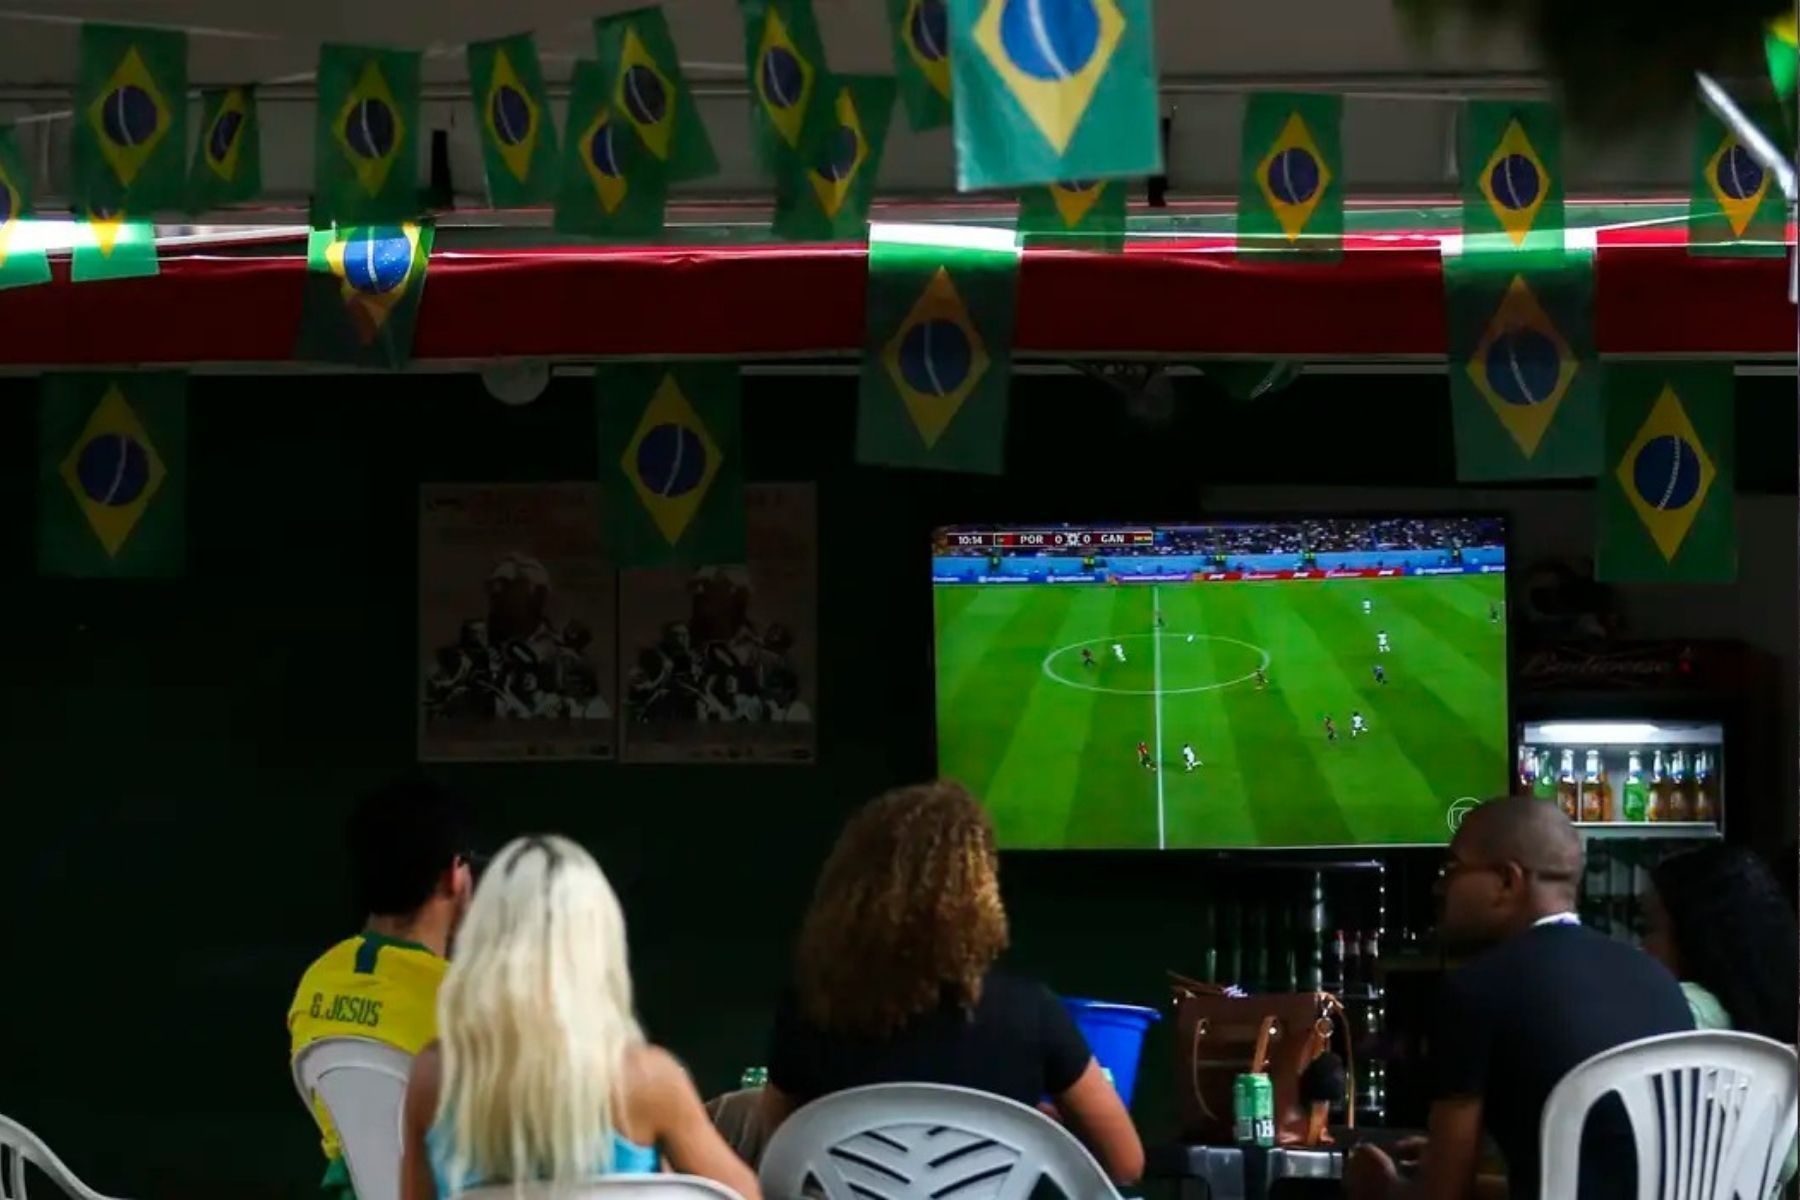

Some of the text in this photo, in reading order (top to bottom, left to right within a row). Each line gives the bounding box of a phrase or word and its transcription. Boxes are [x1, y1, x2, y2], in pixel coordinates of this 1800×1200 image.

[958, 534, 1125, 545] 10:14 POR 0 0 GAN
